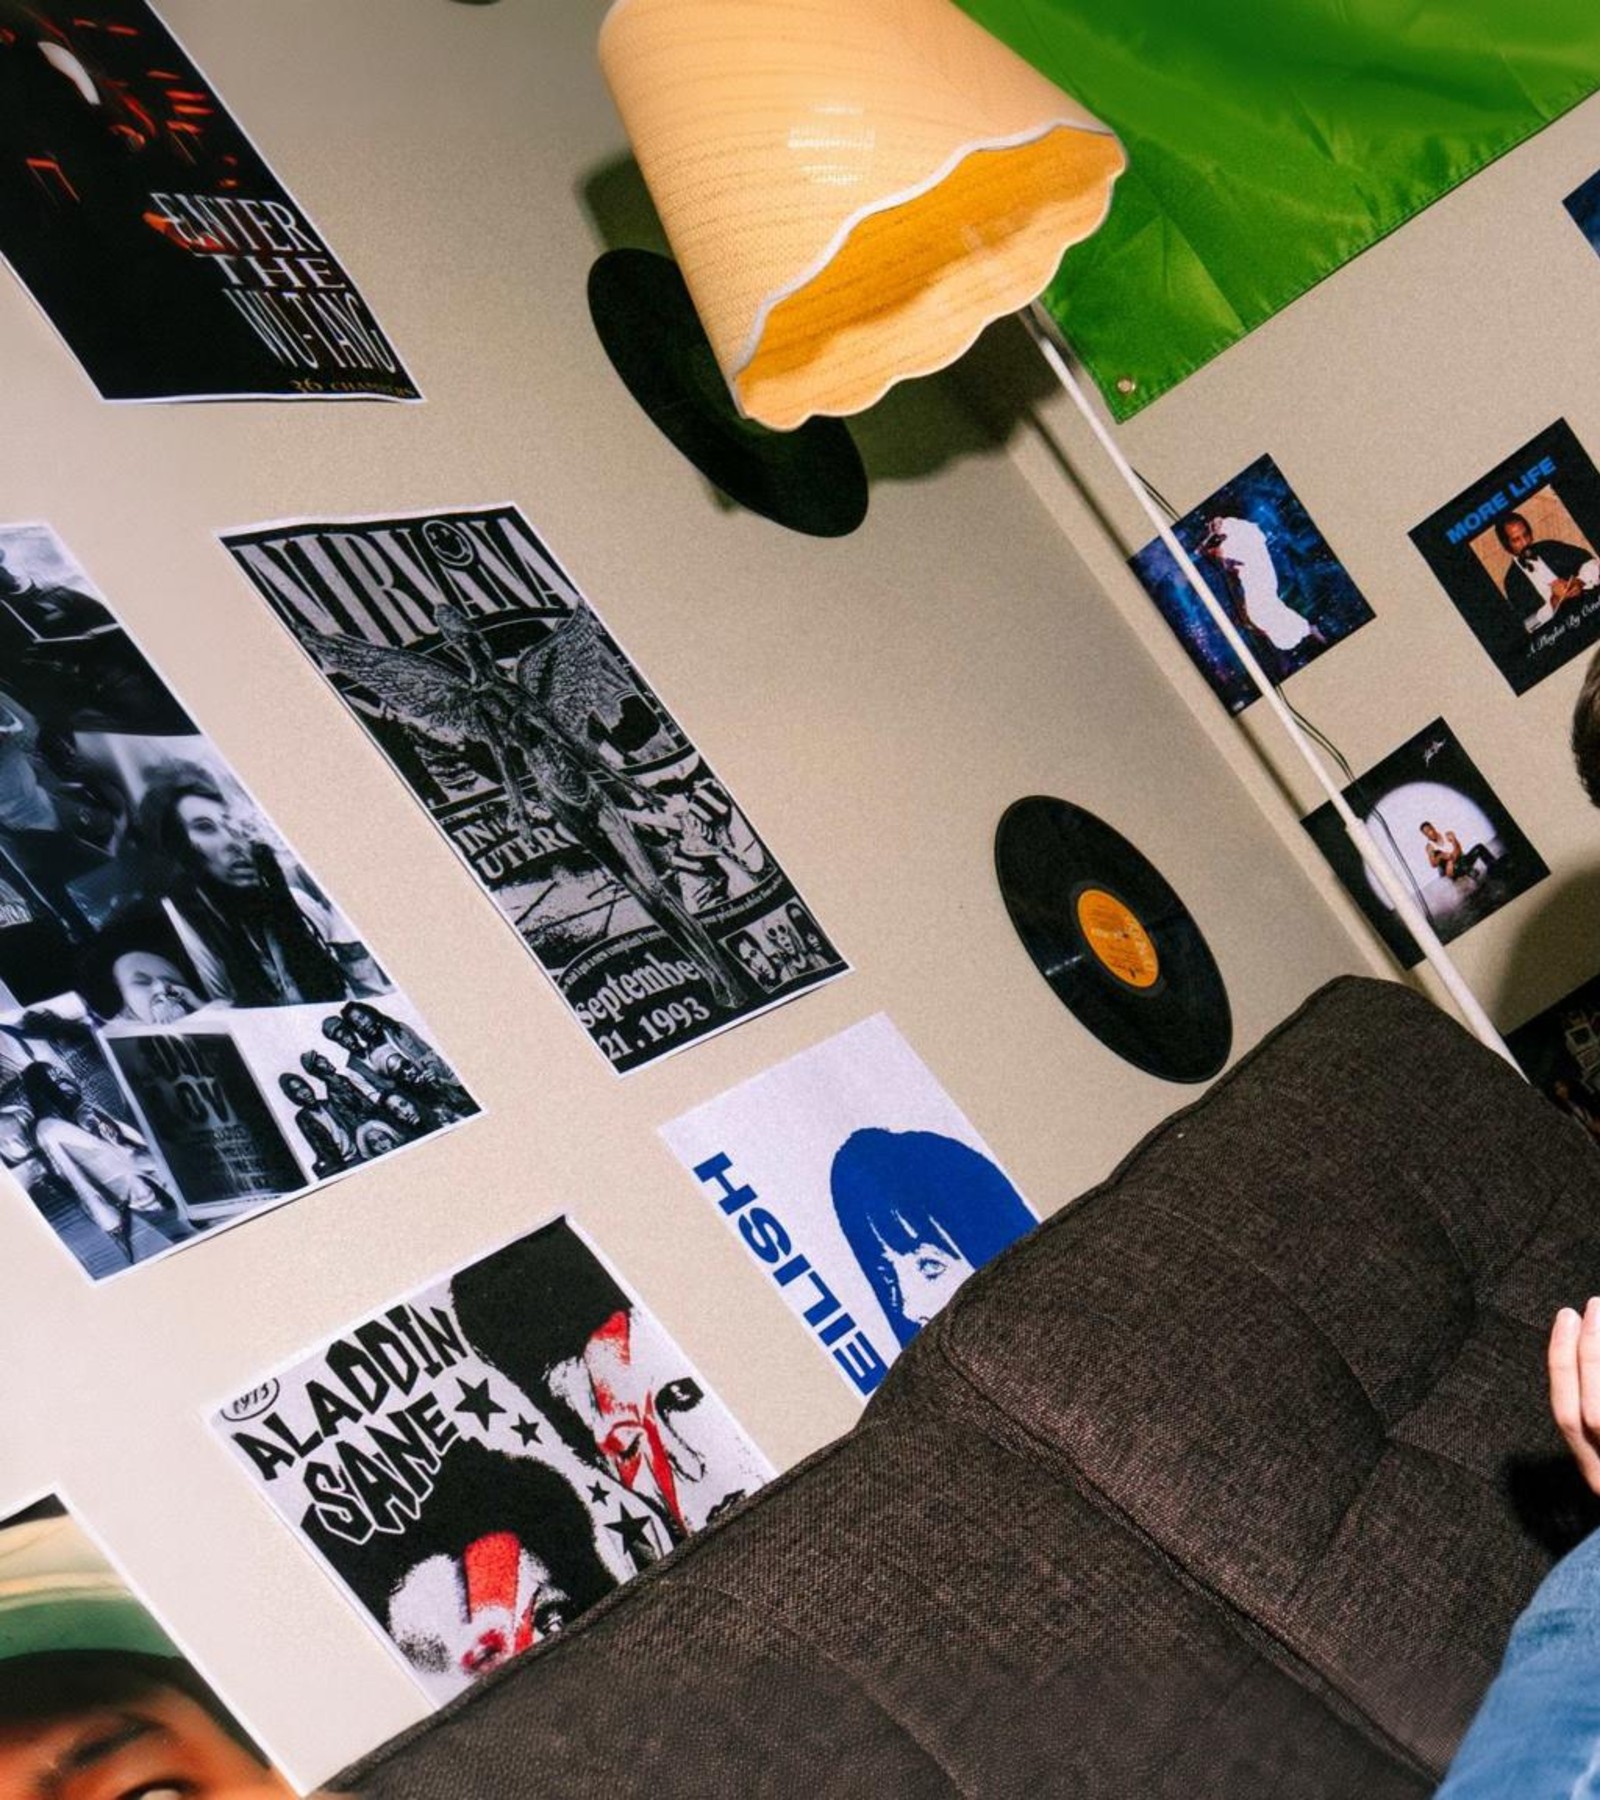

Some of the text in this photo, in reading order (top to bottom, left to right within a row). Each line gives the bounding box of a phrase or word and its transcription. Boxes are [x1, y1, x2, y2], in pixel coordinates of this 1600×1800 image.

[150, 192, 322, 252] ENTER
[194, 251, 346, 288] THE
[222, 286, 397, 374] WU-TANG
[290, 378, 323, 394] 36
[1445, 455, 1557, 545] MORE LIFE
[228, 516, 580, 649] NIRVANA
[598, 1029, 635, 1061] 21
[637, 996, 712, 1043] 1993
[693, 1151, 890, 1397] EILISH
[230, 1302, 469, 1483] ALADDIN
[302, 1390, 461, 1546] SANE
